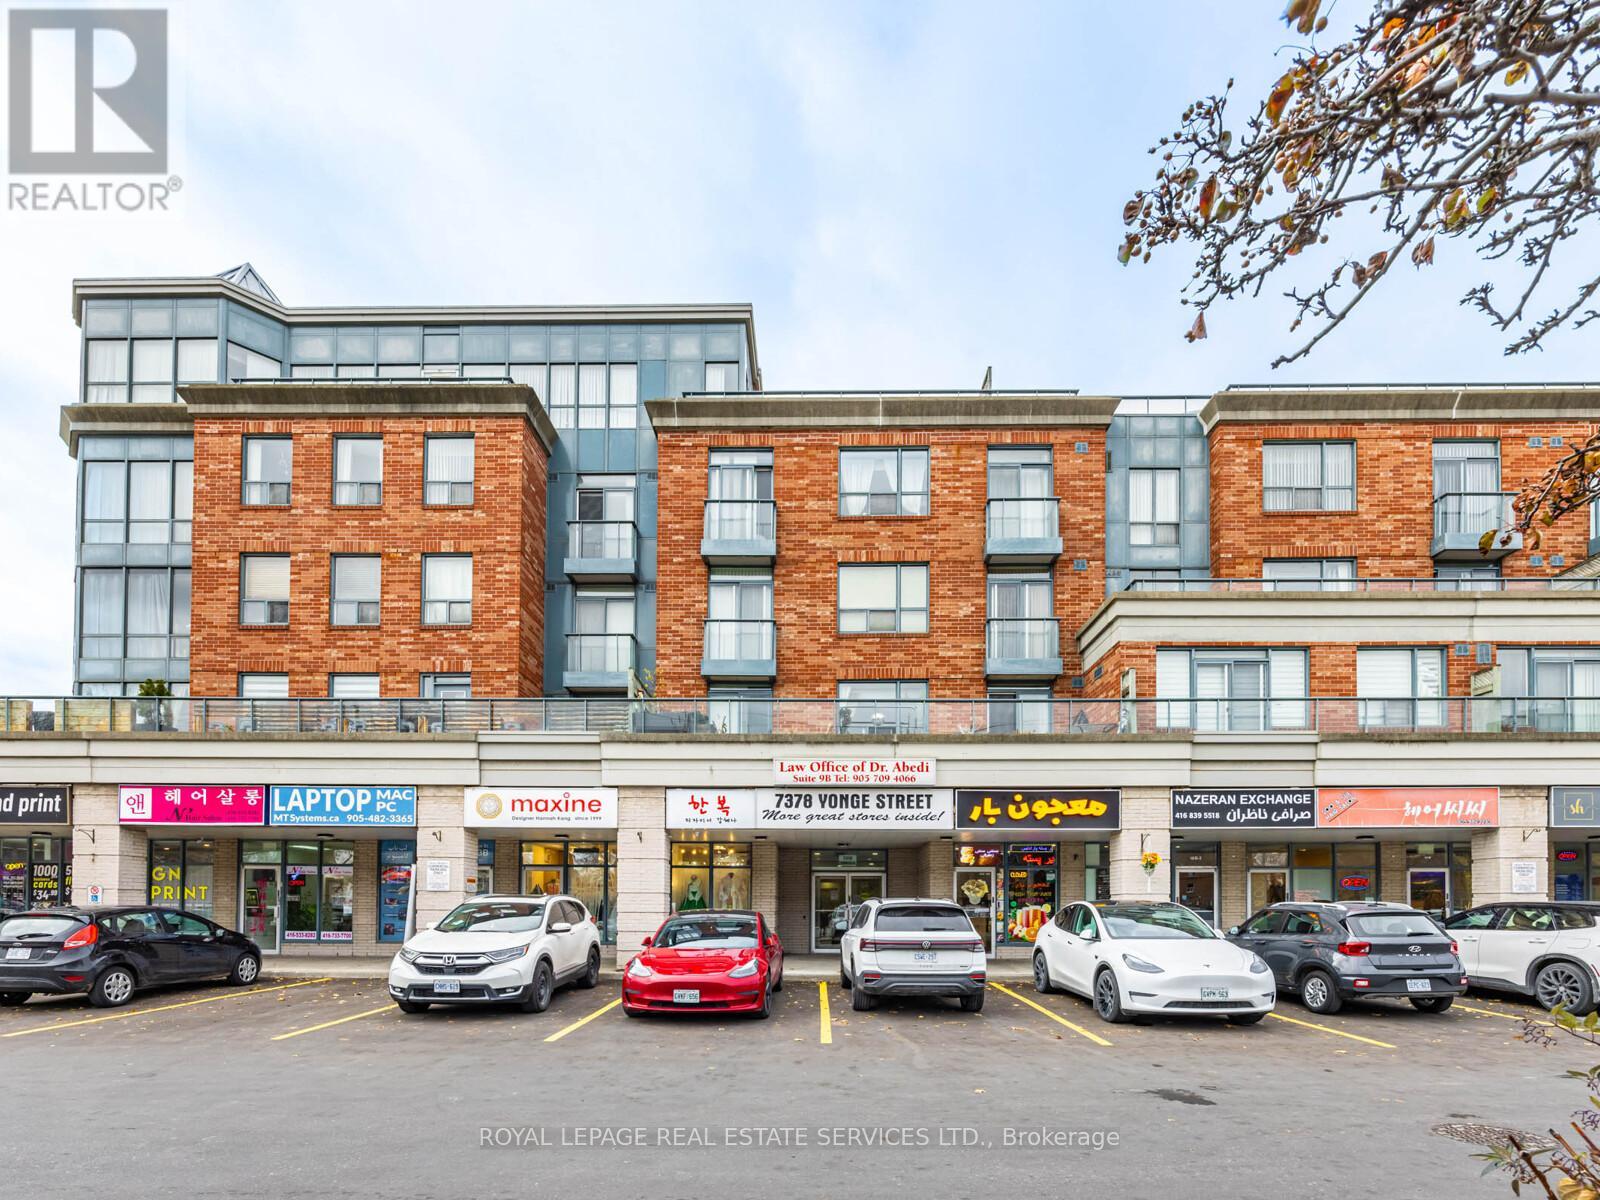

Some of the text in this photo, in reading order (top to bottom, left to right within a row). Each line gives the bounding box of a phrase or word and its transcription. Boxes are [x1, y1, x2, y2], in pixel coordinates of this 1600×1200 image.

[780, 761, 929, 773] Law Office of Dr. Abedi
[793, 775, 916, 783] Suite 9B Tel: 905 709 4066
[18, 793, 62, 817] print
[273, 788, 413, 812] LAPTOP MAC
[376, 801, 397, 812] PC
[511, 792, 602, 813] maxine
[775, 793, 933, 810] 7378 YONGE STREET
[1175, 794, 1312, 805] NAZERAN EXCHANGE
[762, 809, 945, 824] More great stores inside!
[969, 793, 1108, 826] معجون بار
[1226, 808, 1268, 823] ناظران
[346, 814, 413, 823] 905-482-3365
[33, 865, 58, 877] 1000
[152, 867, 181, 881] GN
[33, 880, 58, 889] cards
[1342, 877, 1369, 888] OPEN
[151, 886, 208, 901] PRINT
